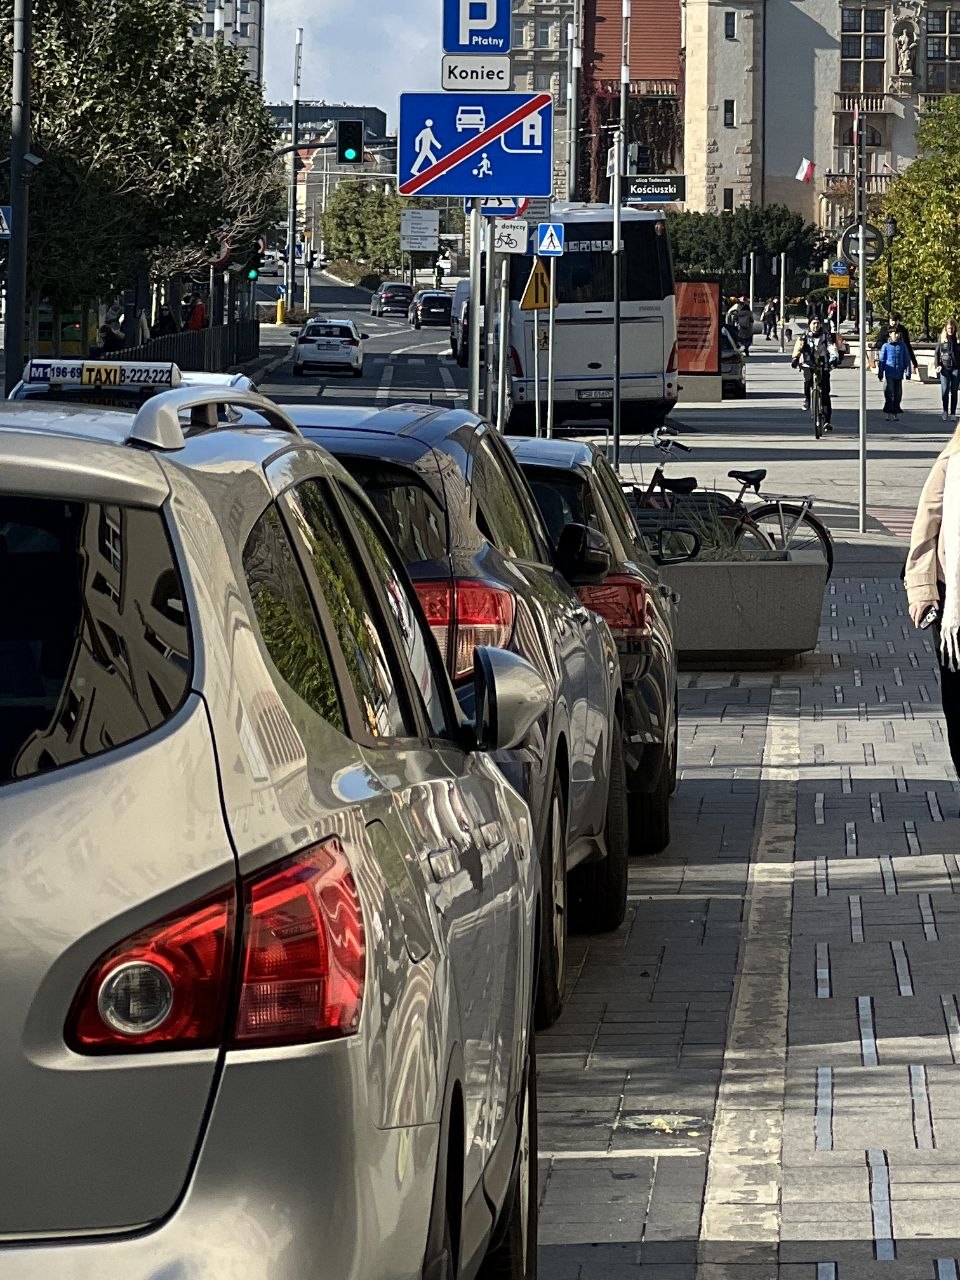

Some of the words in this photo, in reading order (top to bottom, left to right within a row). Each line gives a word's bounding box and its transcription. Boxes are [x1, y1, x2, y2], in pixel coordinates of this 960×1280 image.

[472, 35, 504, 48] Płatny
[448, 65, 505, 81] Koniec
[630, 184, 677, 194] Kościuszki
[501, 223, 526, 231] dotyczy
[31, 367, 51, 378] M1
[86, 367, 118, 385] TAXI
